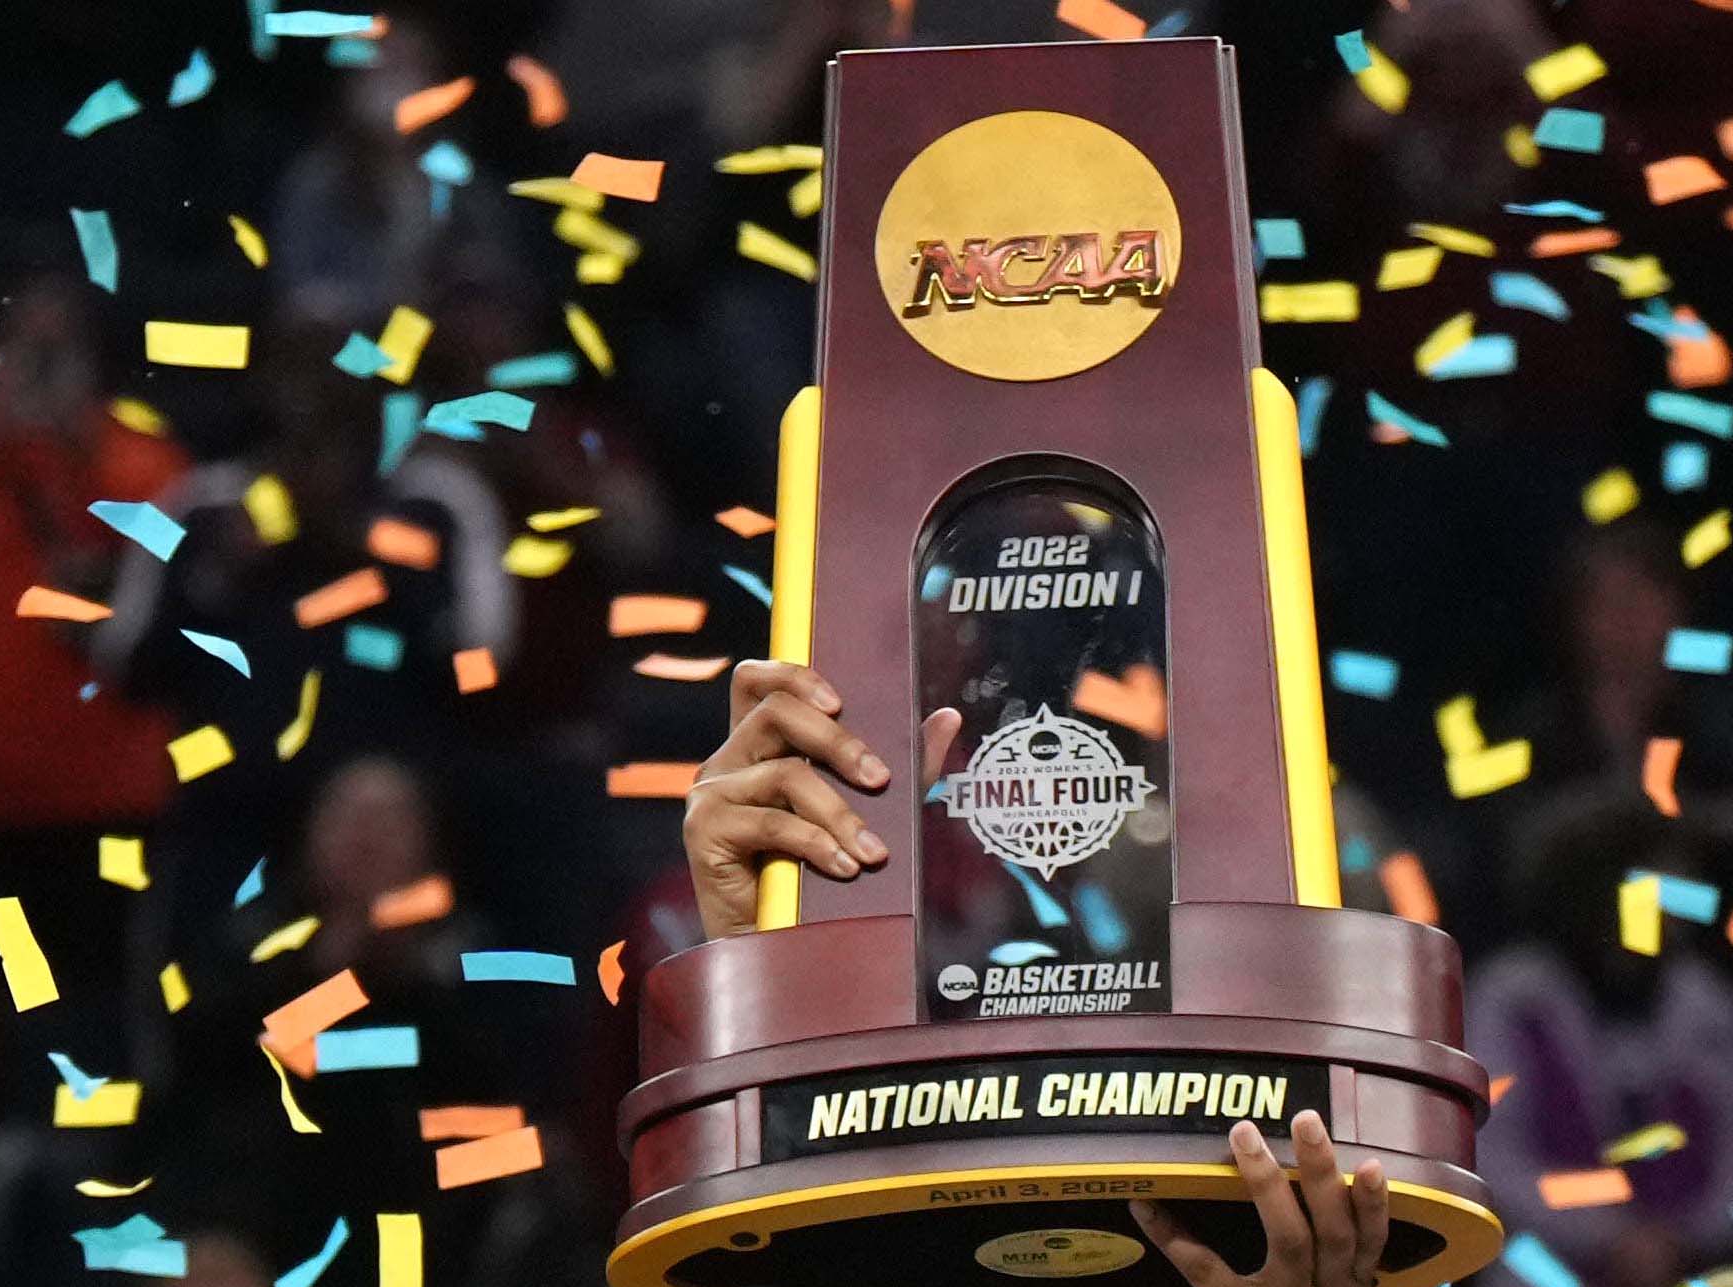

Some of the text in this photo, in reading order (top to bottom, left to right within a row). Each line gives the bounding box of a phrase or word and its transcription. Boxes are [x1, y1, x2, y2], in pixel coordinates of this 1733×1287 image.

[902, 229, 1169, 314] NCAA
[997, 534, 1091, 570] 2022
[949, 571, 1142, 614] DIVISION I
[998, 764, 1094, 776] 2022 WOMEN'S
[956, 775, 1134, 810] FINAL FOUR
[1002, 809, 1088, 819] MINNEAPOLIS
[983, 961, 1162, 996] BASKETBALL
[979, 992, 1132, 1017] CHAMPIONSHIP
[808, 1066, 1288, 1142] NATIONAL CHAMPION
[930, 1179, 1156, 1204] April 3, 2022
